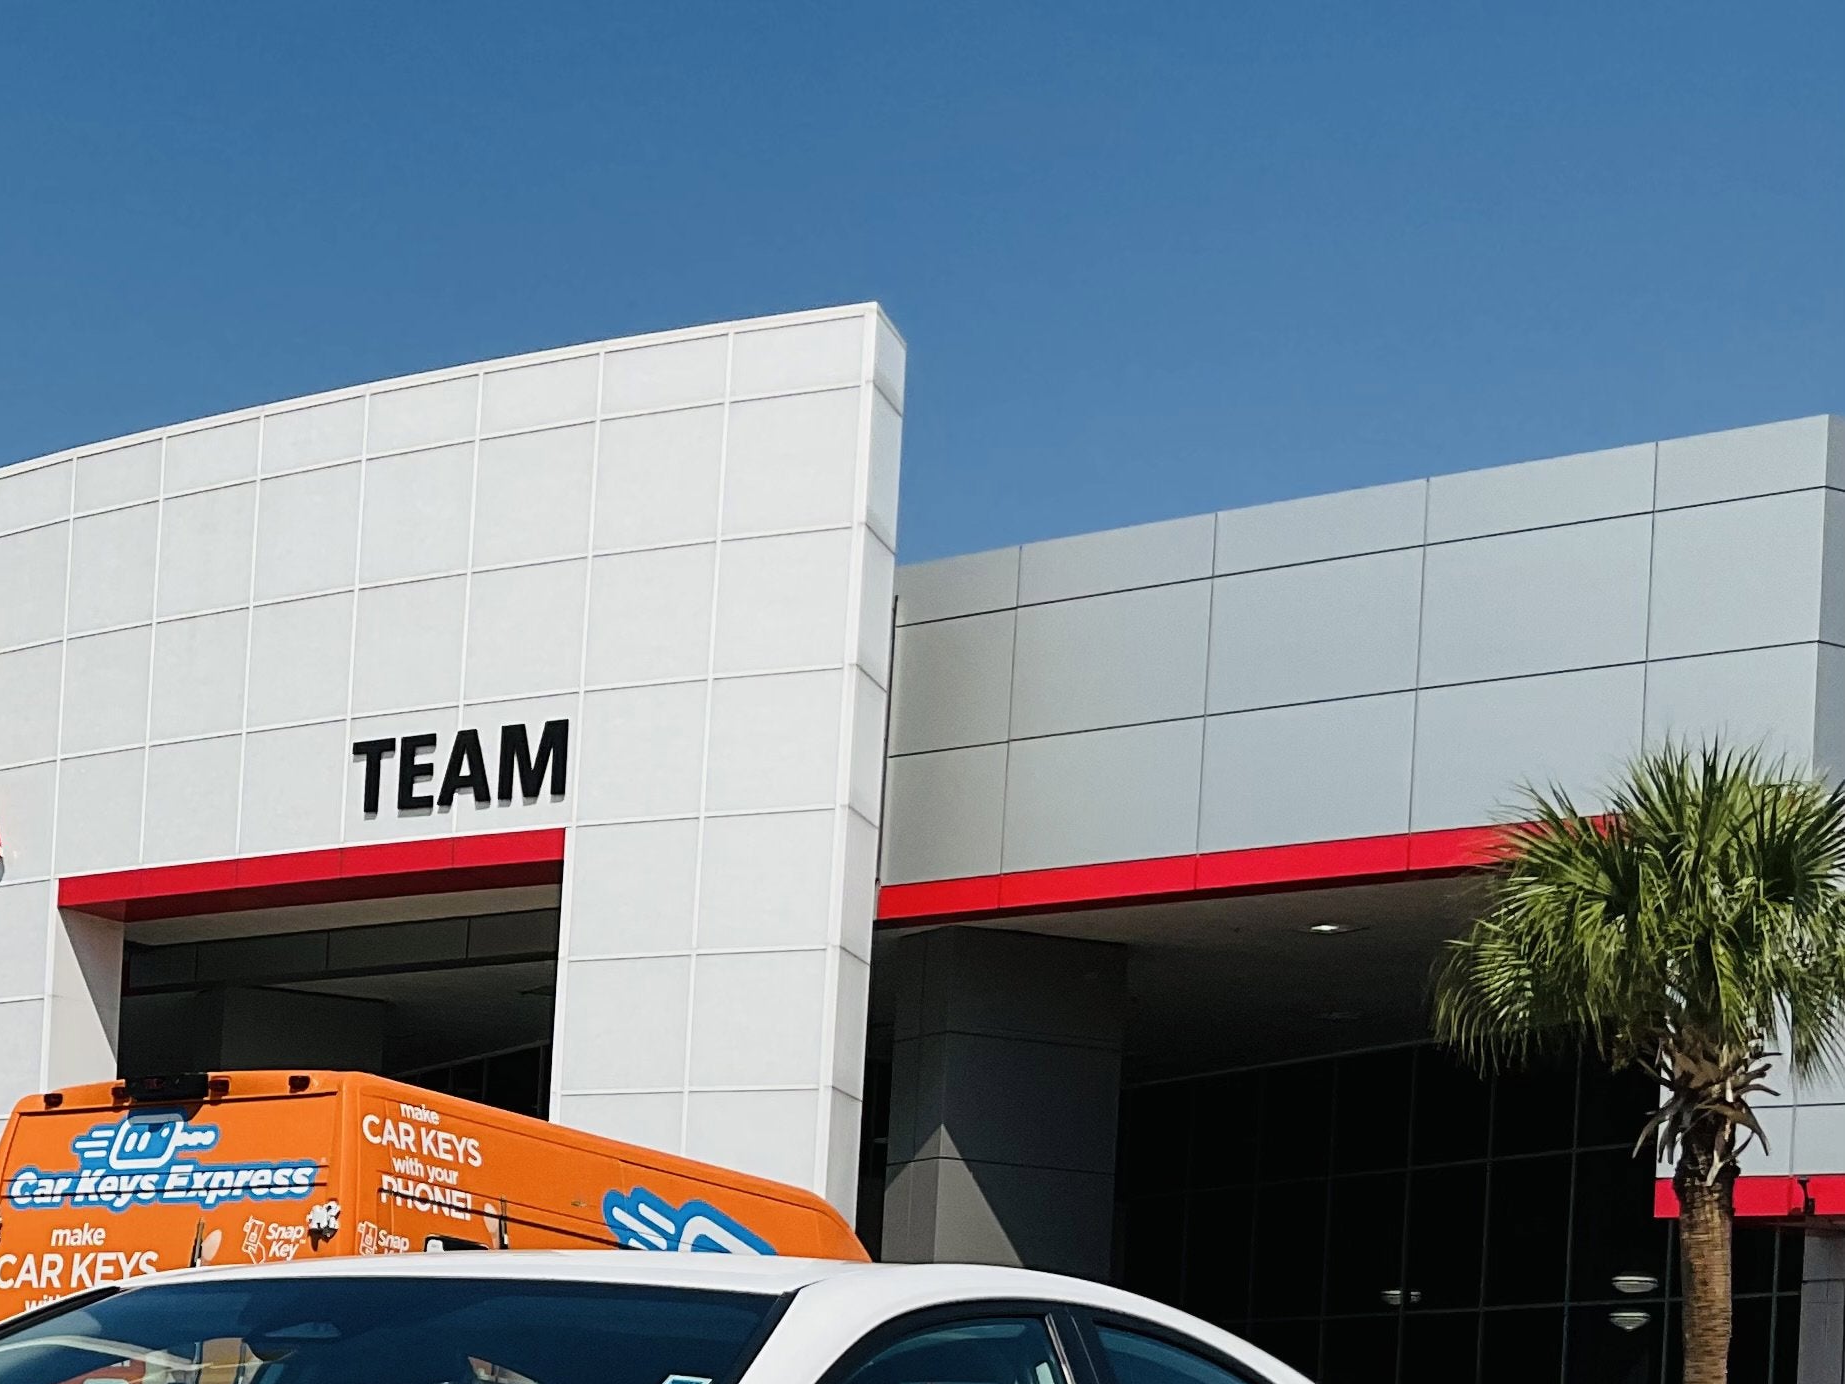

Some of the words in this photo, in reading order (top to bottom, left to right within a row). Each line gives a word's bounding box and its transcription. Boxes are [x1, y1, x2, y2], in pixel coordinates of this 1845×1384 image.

[352, 719, 569, 814] TEAM
[399, 1103, 440, 1125] make
[362, 1114, 417, 1153] CAR
[420, 1127, 482, 1167] KEYS
[392, 1156, 424, 1177] with
[426, 1164, 459, 1185] your
[10, 1171, 72, 1204] Car
[74, 1168, 158, 1207] Keys
[162, 1164, 314, 1205] Express
[380, 1174, 472, 1221] PHONE!
[50, 1222, 106, 1247] make
[265, 1223, 305, 1245] Snap
[377, 1229, 410, 1253] Snap
[268, 1240, 299, 1261] Key
[70, 1250, 159, 1289] KEYS
